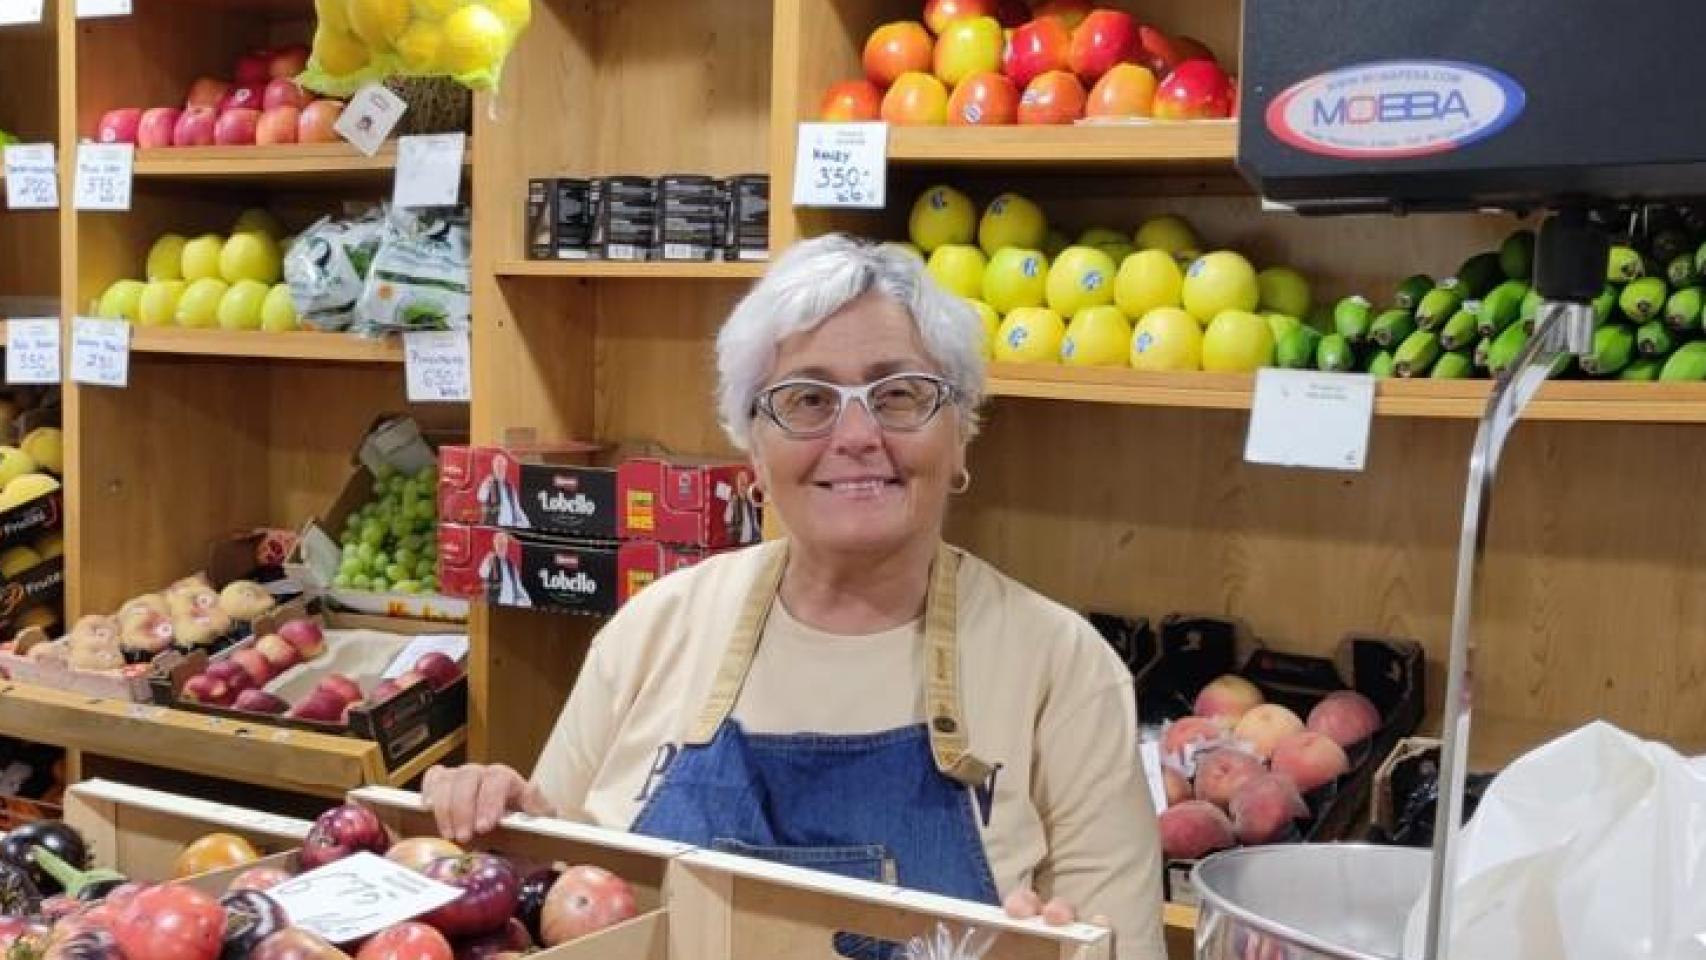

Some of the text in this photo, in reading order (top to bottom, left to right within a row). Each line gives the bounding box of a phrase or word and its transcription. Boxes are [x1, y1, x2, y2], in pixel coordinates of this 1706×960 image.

[1312, 88, 1470, 127] MOBBA
[537, 490, 596, 516] Lobello
[539, 568, 598, 596] Lobello
